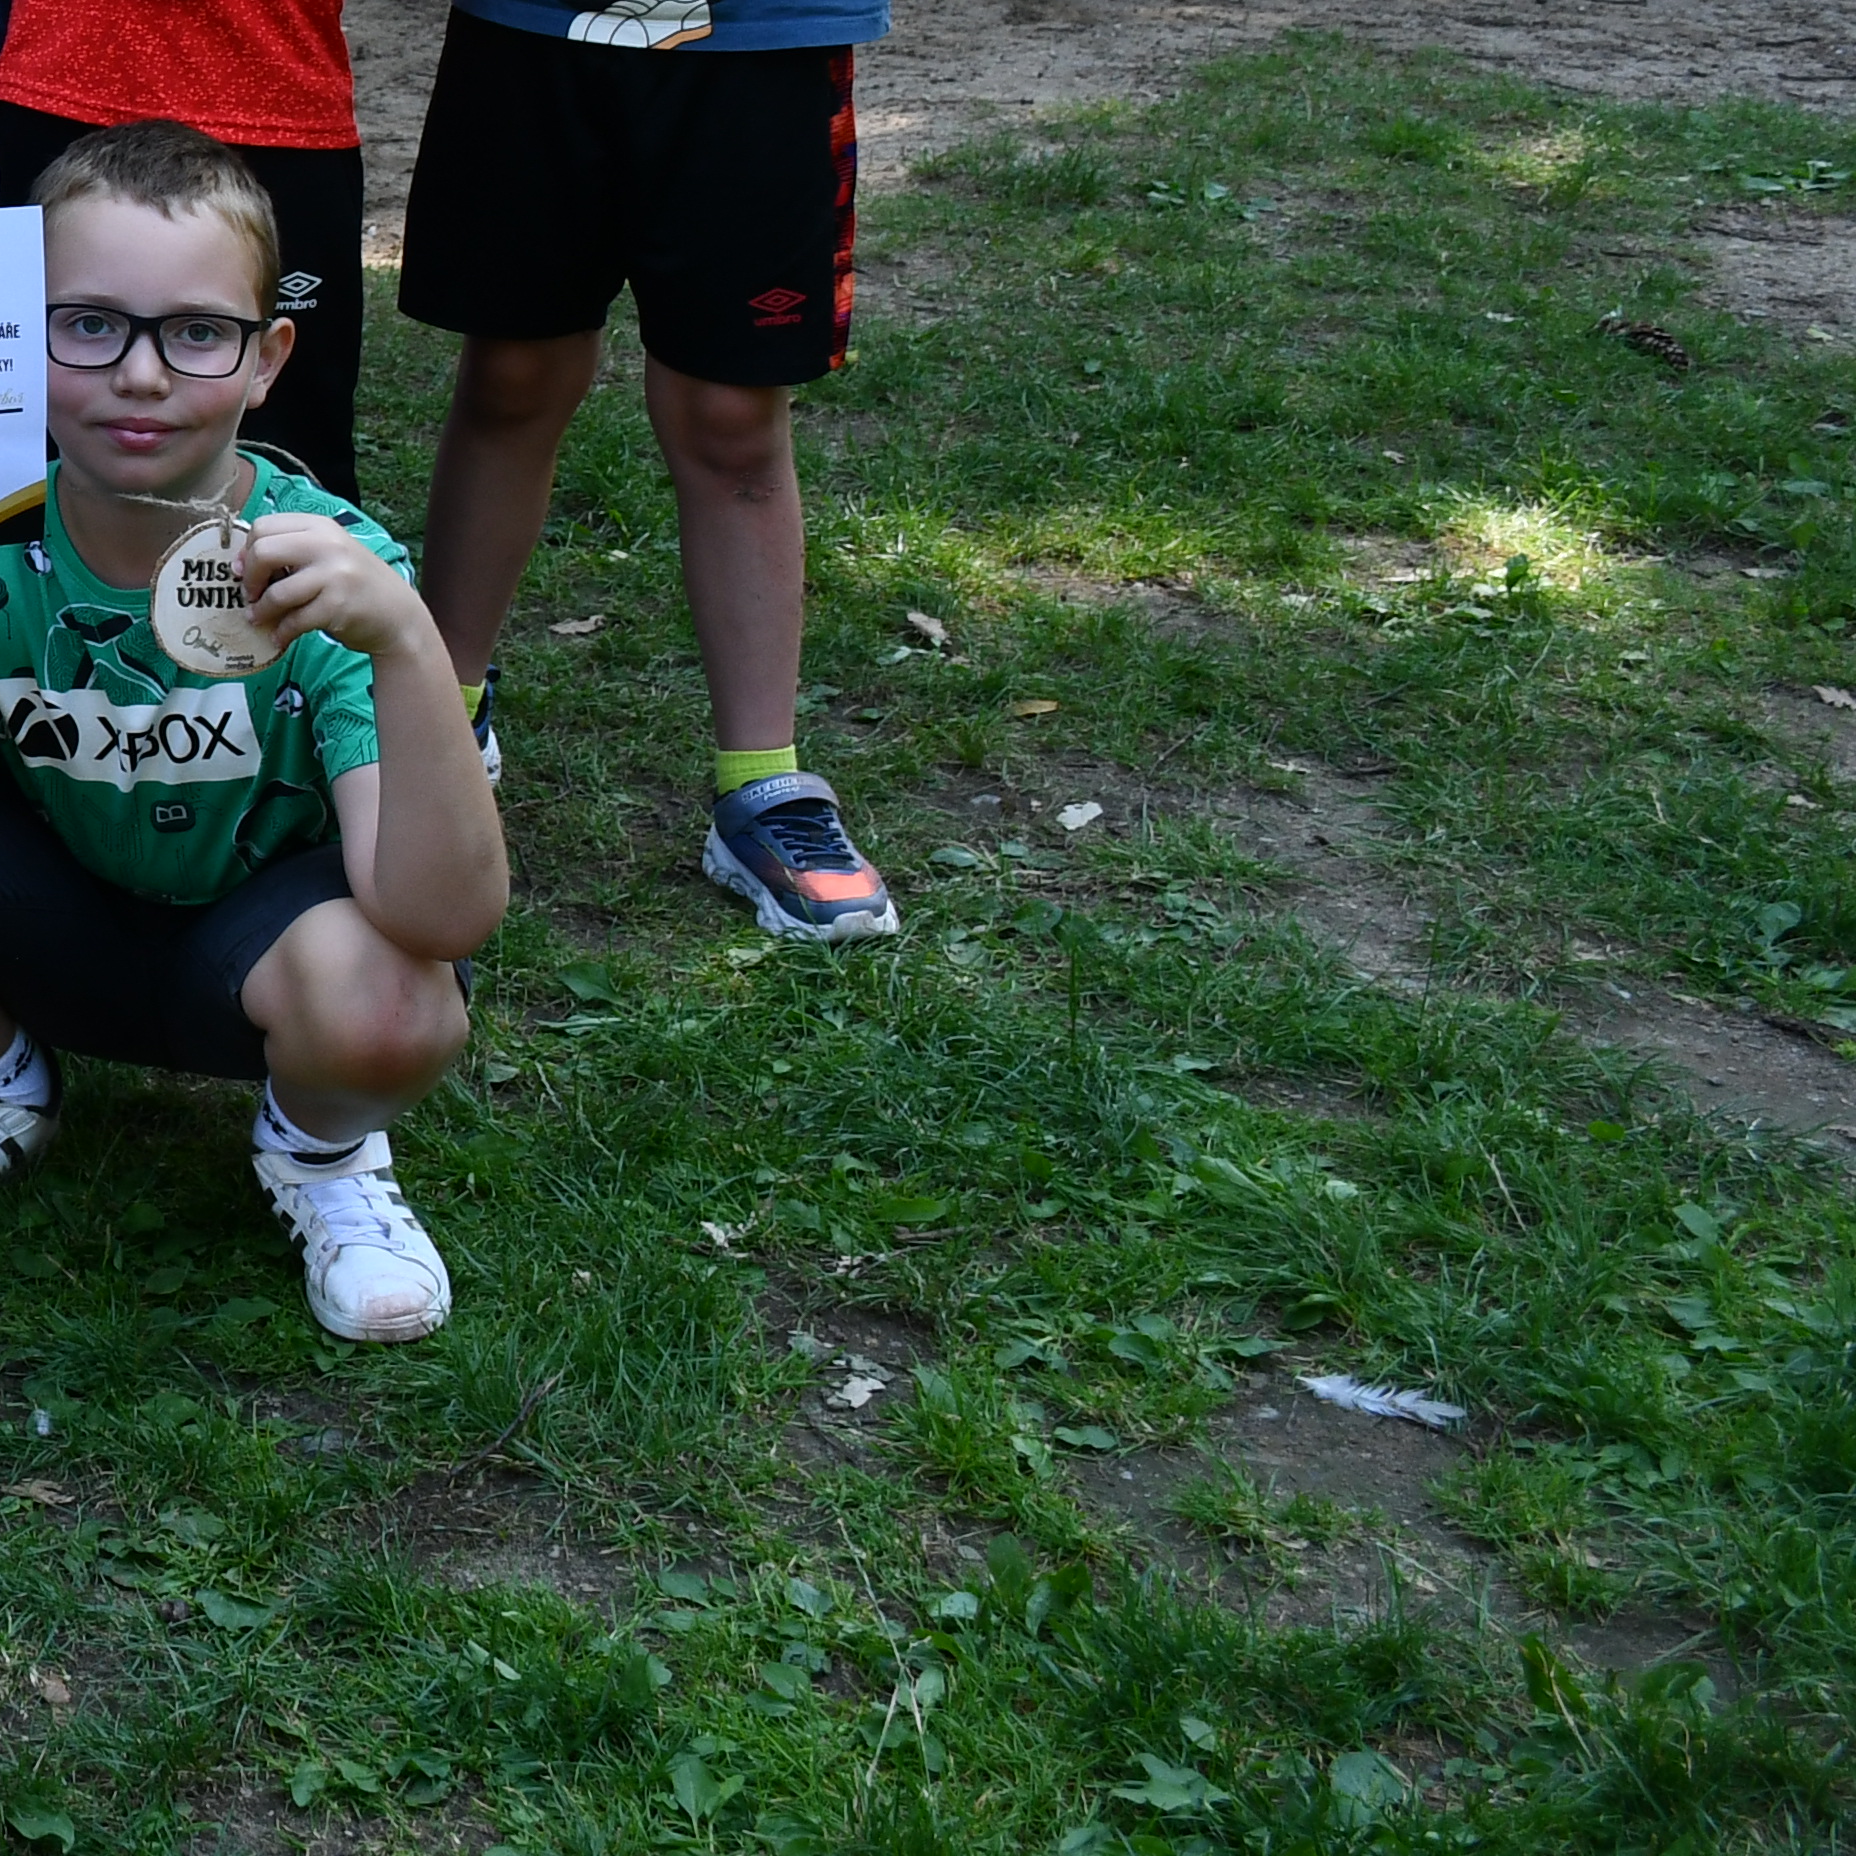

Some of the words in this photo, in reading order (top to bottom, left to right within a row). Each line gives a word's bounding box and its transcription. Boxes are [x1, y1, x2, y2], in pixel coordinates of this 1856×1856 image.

[754, 311, 801, 326] umbro
[181, 558, 234, 582] MIS
[176, 581, 245, 609] ÚNIK
